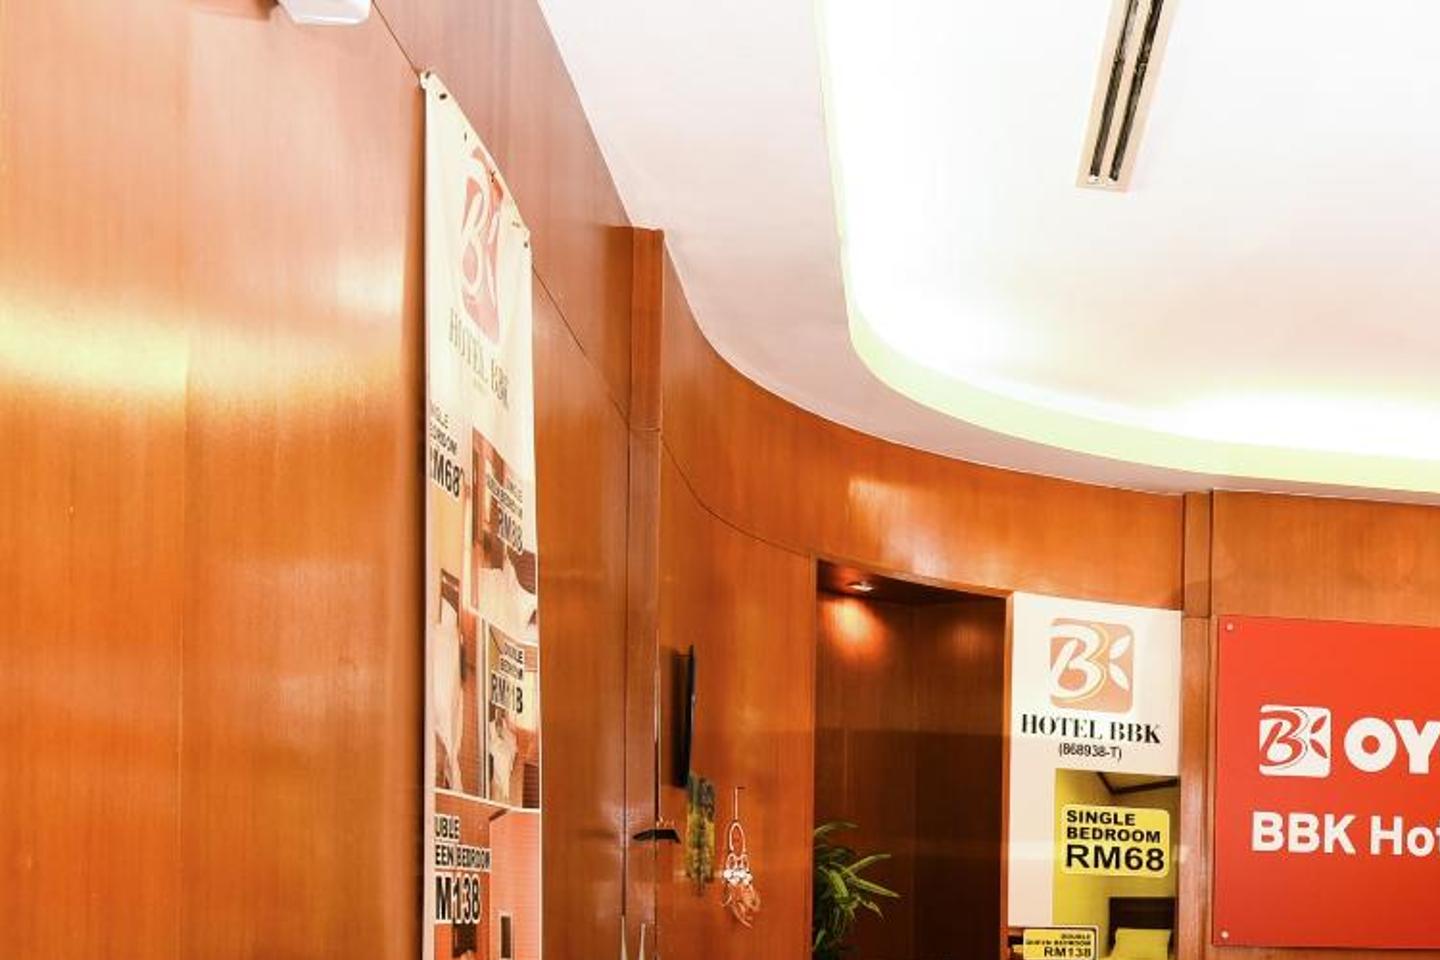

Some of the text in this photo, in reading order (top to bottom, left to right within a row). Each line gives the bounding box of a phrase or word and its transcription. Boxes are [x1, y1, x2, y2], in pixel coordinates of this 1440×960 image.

[1021, 713, 1161, 744] HOTEL BBK
[1066, 809, 1136, 826] SINGLE
[1066, 826, 1161, 844] BEDROOM
[1251, 811, 1357, 855] BBK
[1064, 843, 1165, 872] RM68
